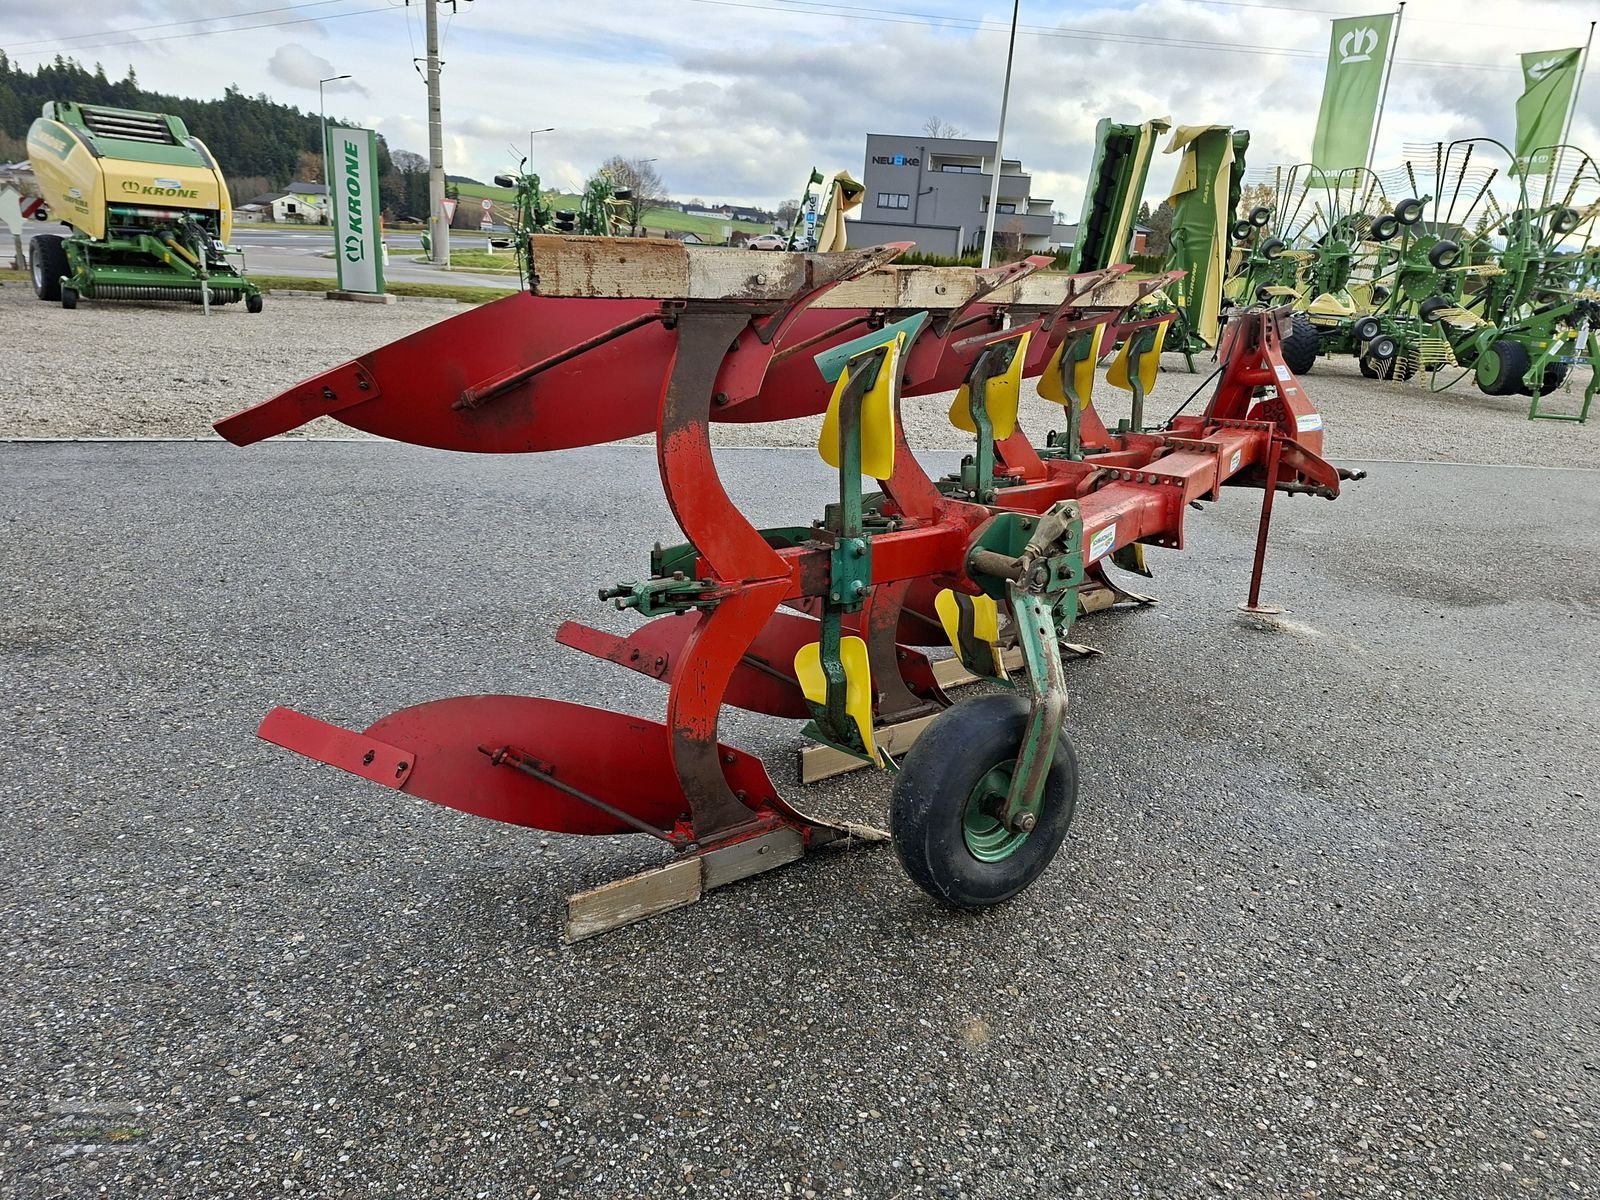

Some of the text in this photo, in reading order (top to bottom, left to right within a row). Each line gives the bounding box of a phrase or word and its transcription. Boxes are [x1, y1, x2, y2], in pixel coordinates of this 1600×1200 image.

[142, 186, 199, 199] KRONE
[344, 140, 363, 234] KRONE
[1188, 262, 1198, 297] KRONE
